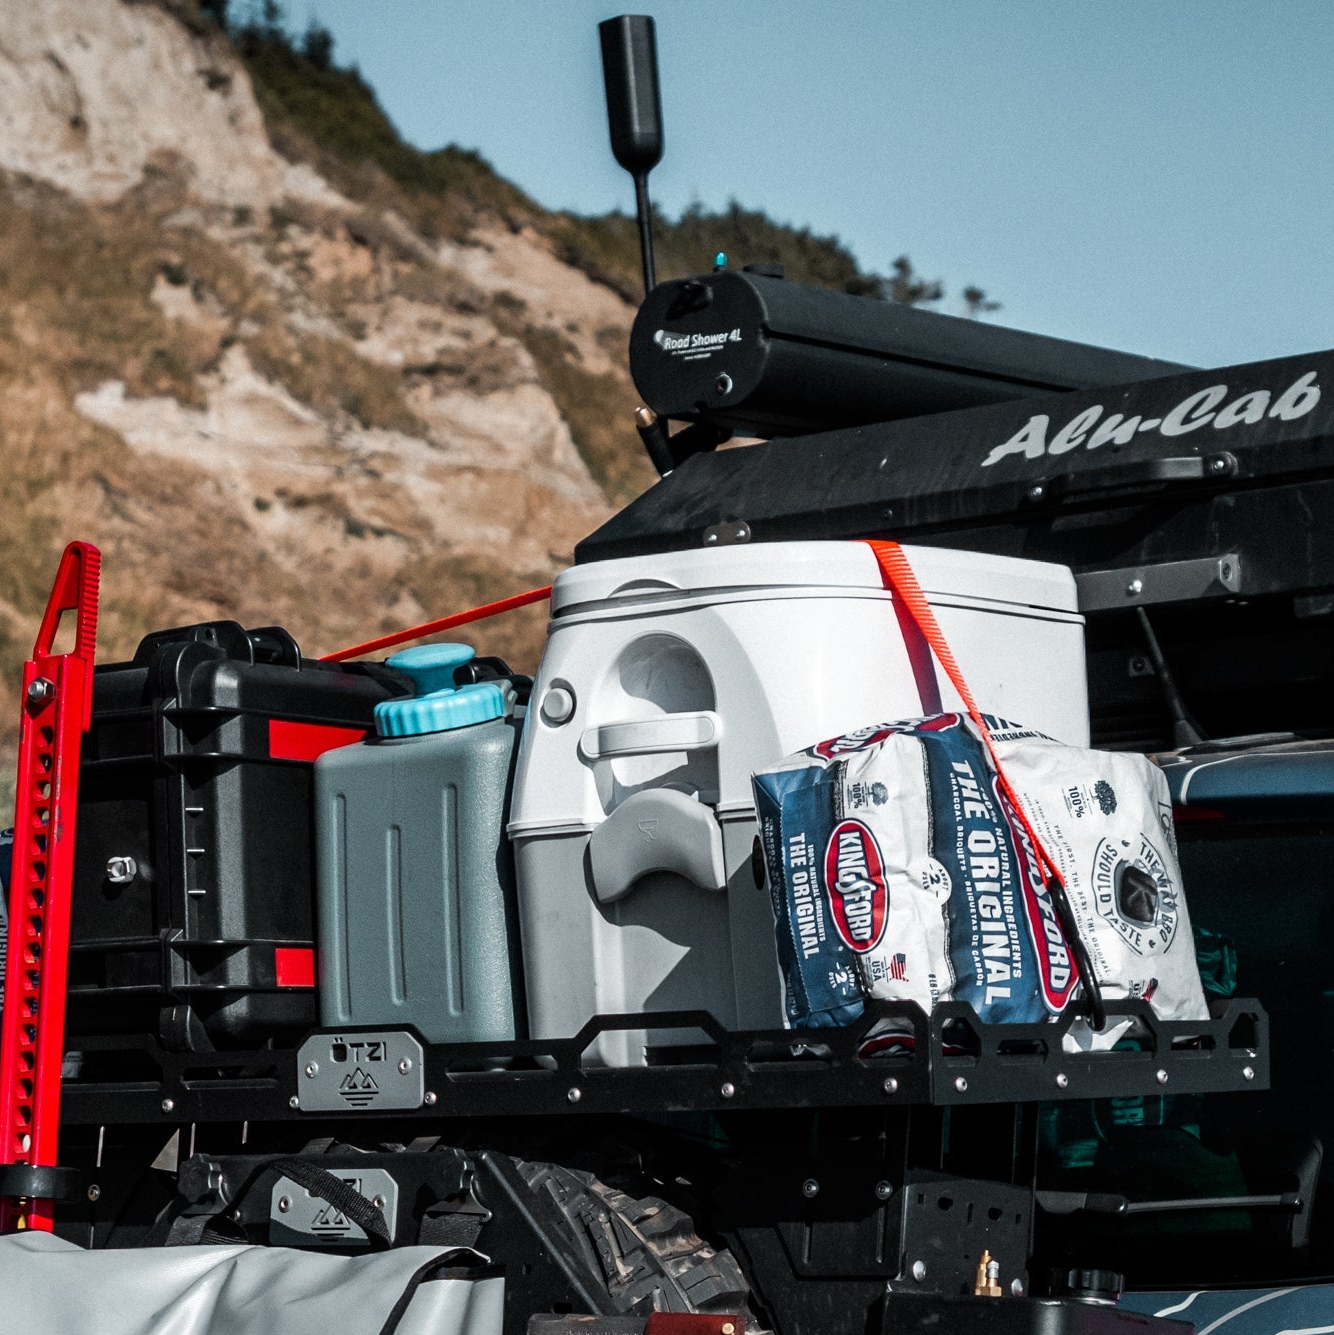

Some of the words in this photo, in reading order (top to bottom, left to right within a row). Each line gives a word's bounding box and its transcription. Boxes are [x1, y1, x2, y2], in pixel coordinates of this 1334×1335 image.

[665, 334, 690, 350] Road
[691, 333, 728, 347] Shower
[729, 328, 742, 341] 4L
[981, 371, 1321, 467] Alu-Cab
[853, 782, 863, 809] 100%
[950, 773, 964, 822] CHARCOAL
[951, 760, 990, 819] THE
[1068, 786, 1085, 818] 100%
[789, 832, 806, 867] THE
[956, 825, 967, 871] BRIQUETS
[995, 827, 1012, 887] NATURAL
[835, 831, 877, 942] KINGSFORD
[929, 873, 941, 885] 2
[938, 868, 949, 891] ABOUT
[1054, 824, 1063, 839] THE
[1071, 872, 1080, 888] THE
[1087, 917, 1095, 933] THE
[1097, 844, 1118, 903] SHOULD
[1140, 841, 1160, 872] THE
[1159, 914, 1174, 943] BBQ
[792, 872, 820, 959] ORIGINAL
[965, 881, 978, 931] BRIQUETAS
[968, 830, 1011, 1005] ORIGINAL
[1103, 908, 1142, 947] TASTE
[971, 935, 979, 947] DE
[1002, 891, 1022, 978] INGREDIENTS
[835, 971, 848, 983] 2
[871, 960, 882, 982] USA
[330, 1037, 387, 1063] ÖTZI
